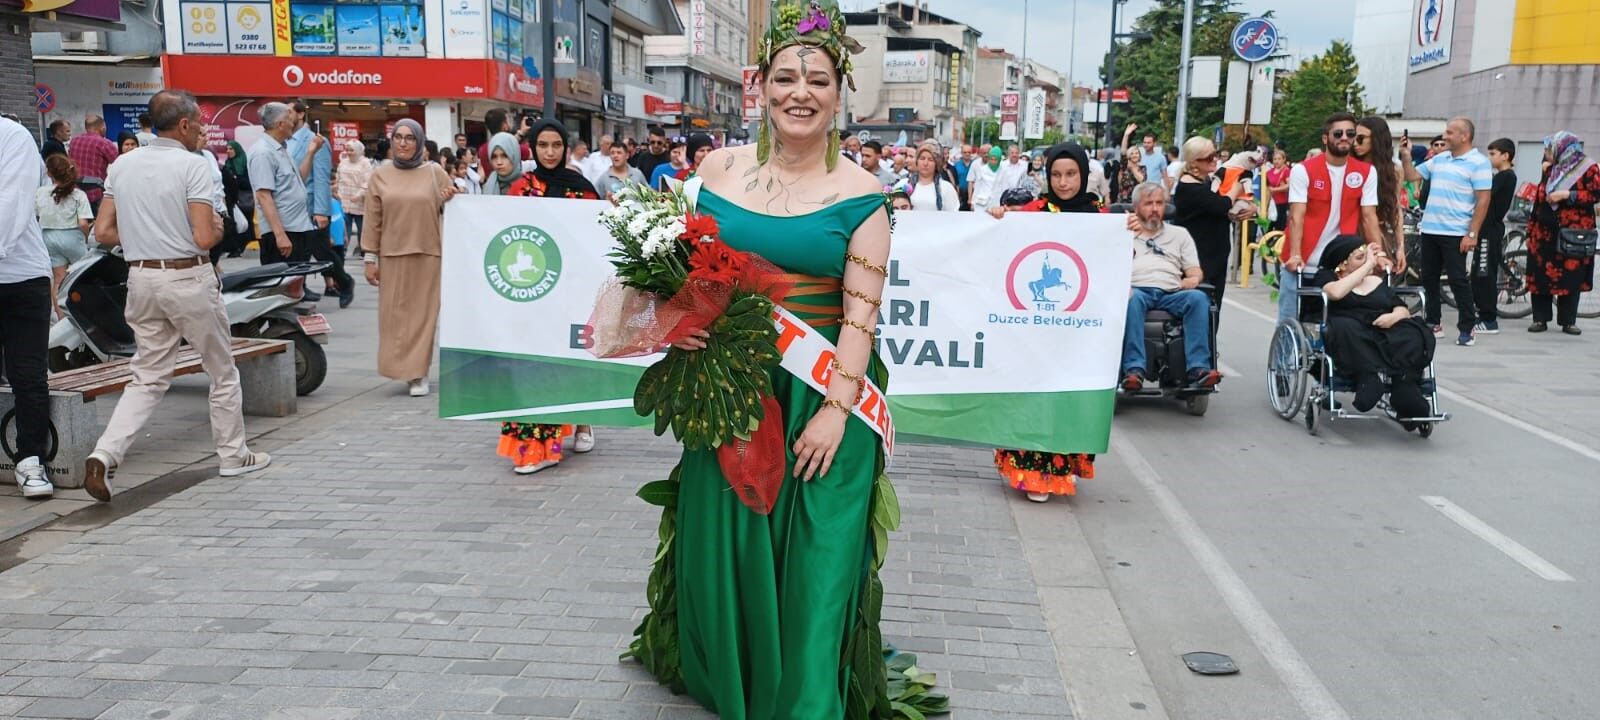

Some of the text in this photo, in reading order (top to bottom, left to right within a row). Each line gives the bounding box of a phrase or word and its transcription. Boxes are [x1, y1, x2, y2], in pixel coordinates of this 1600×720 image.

[274, 0, 288, 41] PEGA
[308, 69, 382, 84] vodafone
[501, 227, 547, 247] DÜZCE
[487, 264, 512, 294] KENT
[889, 259, 910, 286] L
[1033, 315, 1103, 328] Belediyesi
